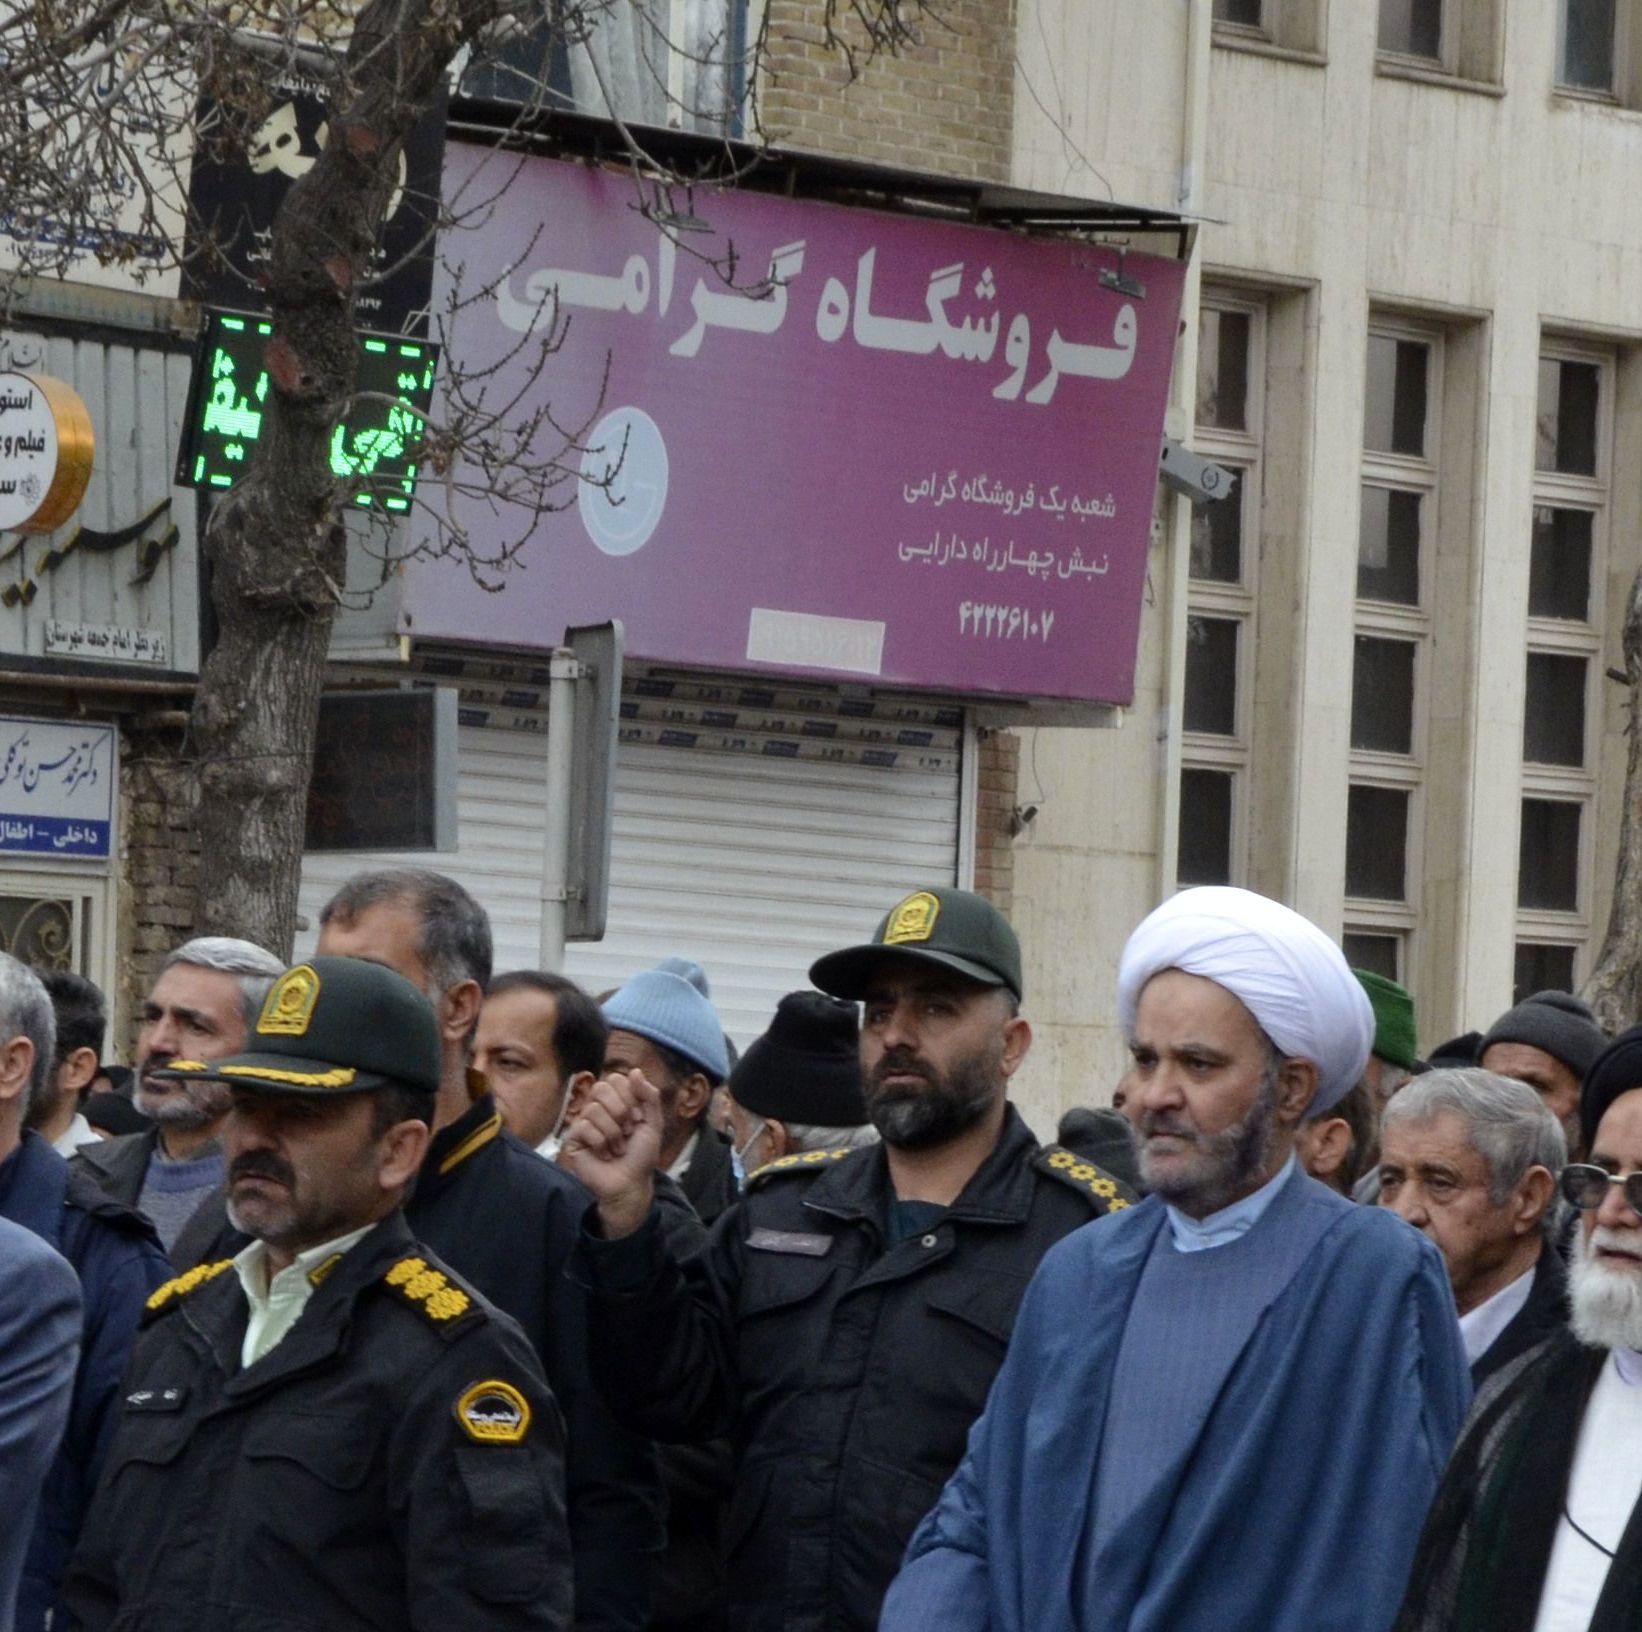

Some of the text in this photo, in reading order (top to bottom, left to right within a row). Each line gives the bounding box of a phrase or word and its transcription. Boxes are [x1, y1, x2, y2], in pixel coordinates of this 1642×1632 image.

[496, 225, 1138, 405] فروشگاه گرامی
[3, 435, 13, 459] و
[14, 428, 46, 459] فیلم
[902, 469, 1117, 523] شعبه یک فروشگاه گرامی
[897, 530, 968, 567] دارایی
[1057, 546, 1109, 581] نبش
[22, 745, 77, 793] حسن
[66, 730, 109, 797] دکتر
[53, 823, 99, 848] داخلی
